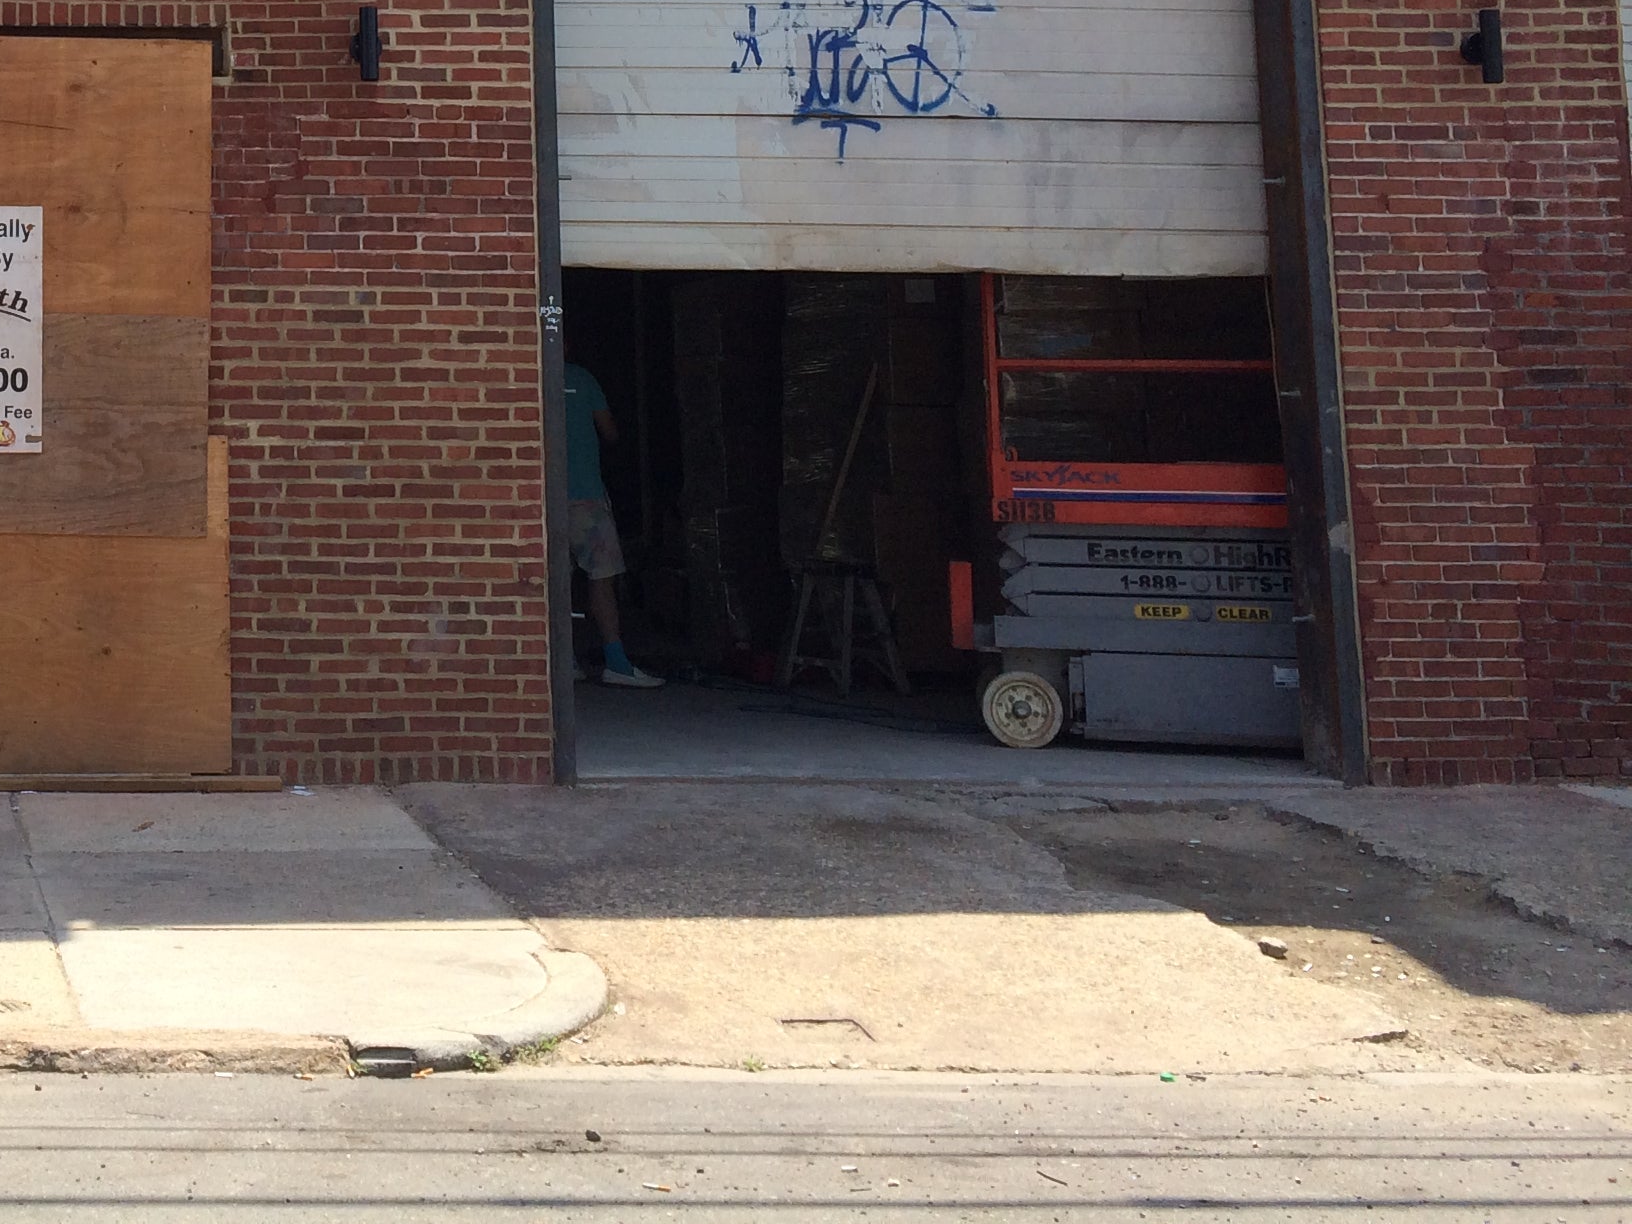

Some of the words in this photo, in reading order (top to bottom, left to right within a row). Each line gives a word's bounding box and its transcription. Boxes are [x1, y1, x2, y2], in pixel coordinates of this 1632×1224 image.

[4, 405, 33, 419] Fee
[1010, 464, 1121, 486] SKYJACK
[1087, 542, 1183, 565] Eastern
[1214, 544, 1291, 568] HighR
[1141, 606, 1183, 618] KEEP
[1218, 607, 1269, 620] CLEAR
